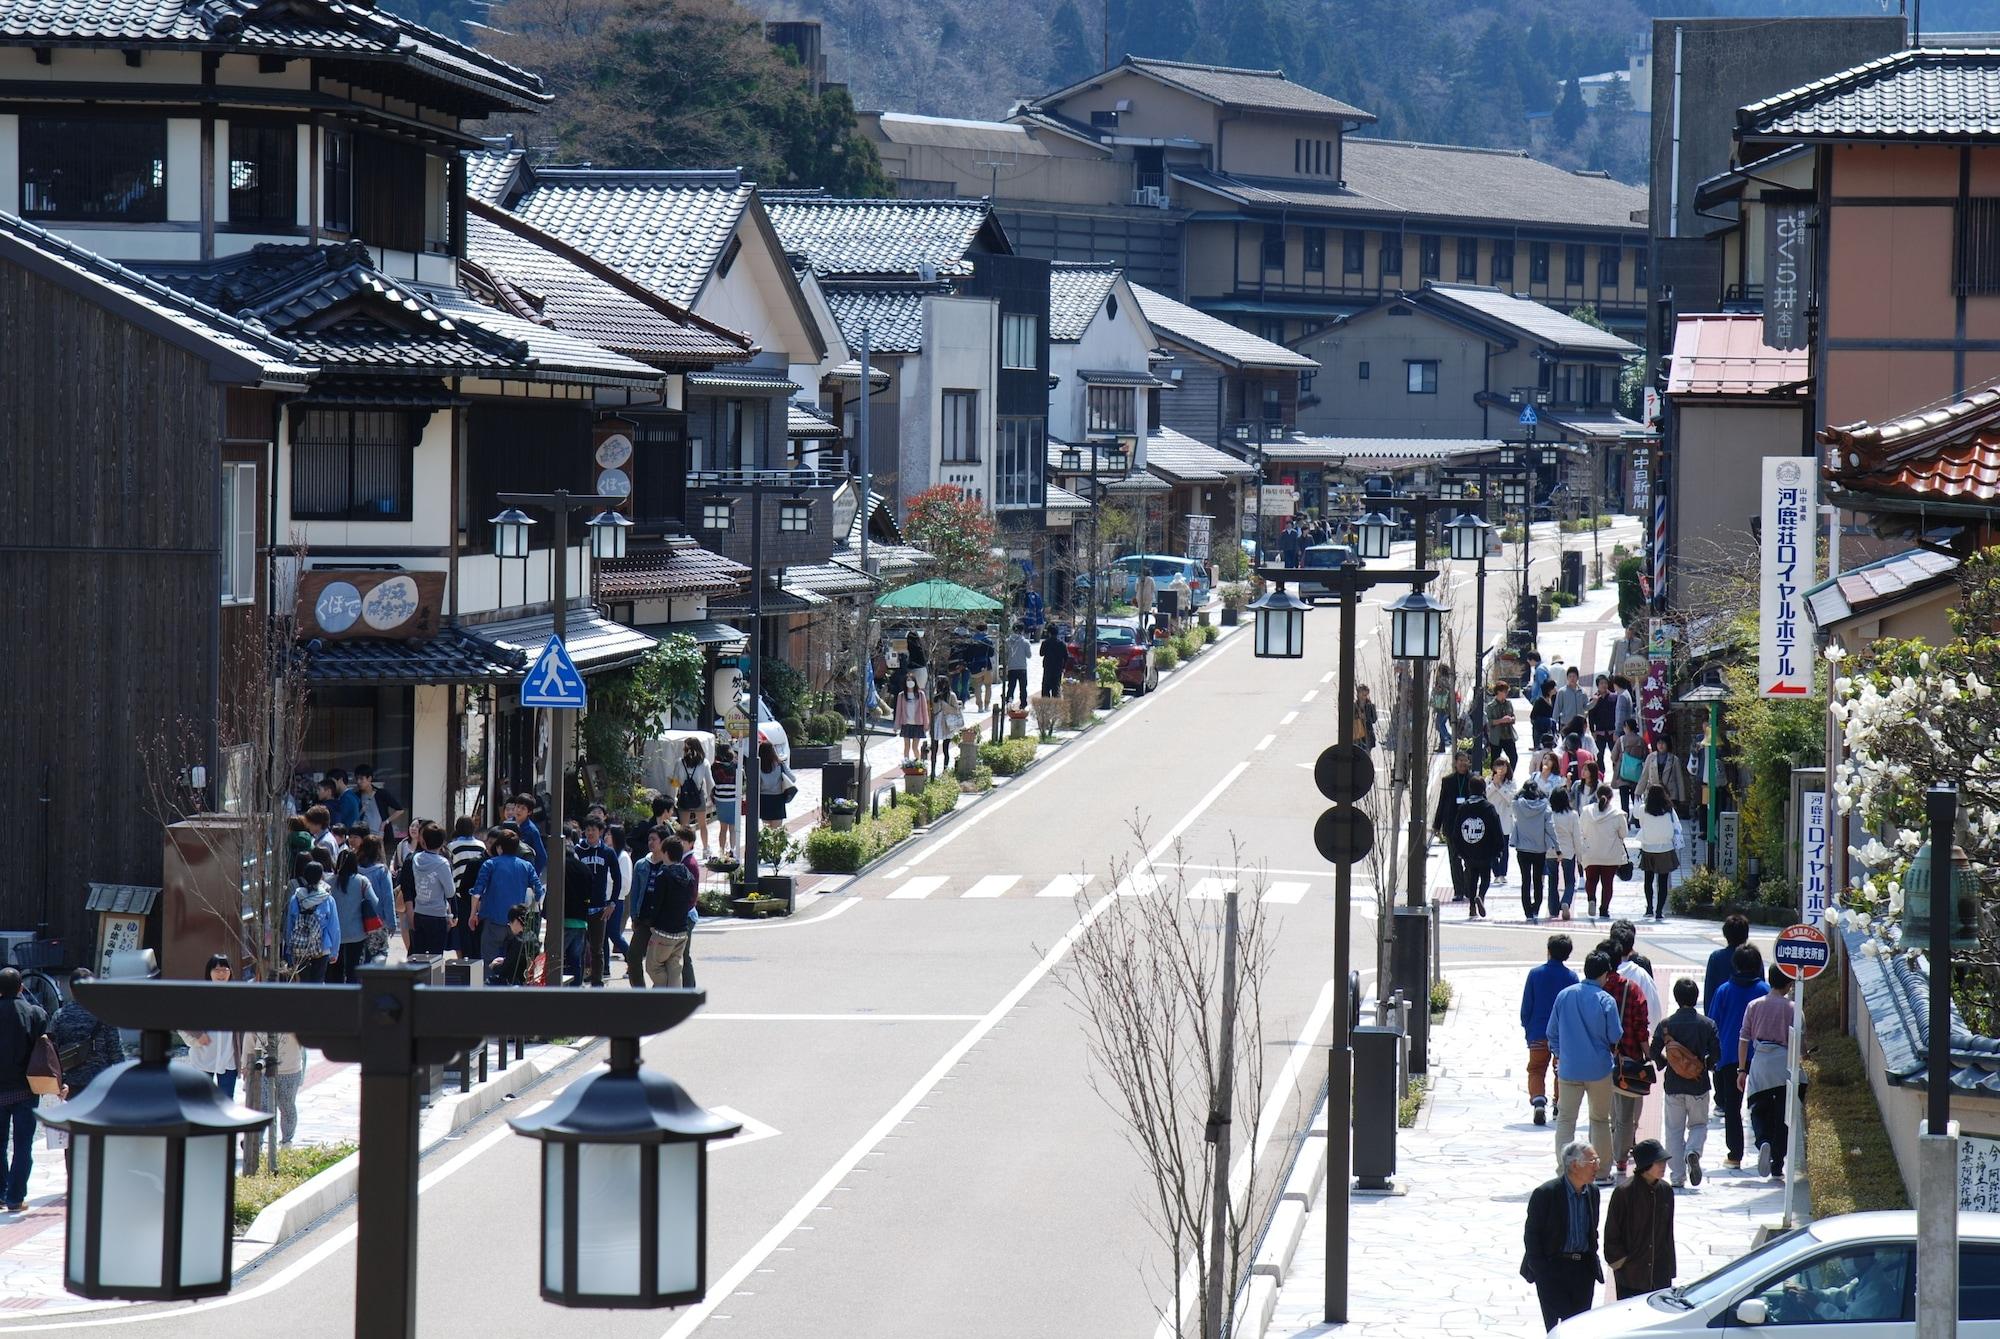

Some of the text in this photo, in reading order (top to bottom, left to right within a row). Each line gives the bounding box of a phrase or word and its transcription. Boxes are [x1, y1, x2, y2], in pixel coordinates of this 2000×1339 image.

[1799, 487, 1807, 522] 山中温泉
[1776, 487, 1798, 676] 河鹿荘ロイヤルホテル
[1807, 795, 1825, 929] 河鹿荘ロイヤルホテ
[1776, 945, 1826, 961] 山中温泉支所前
